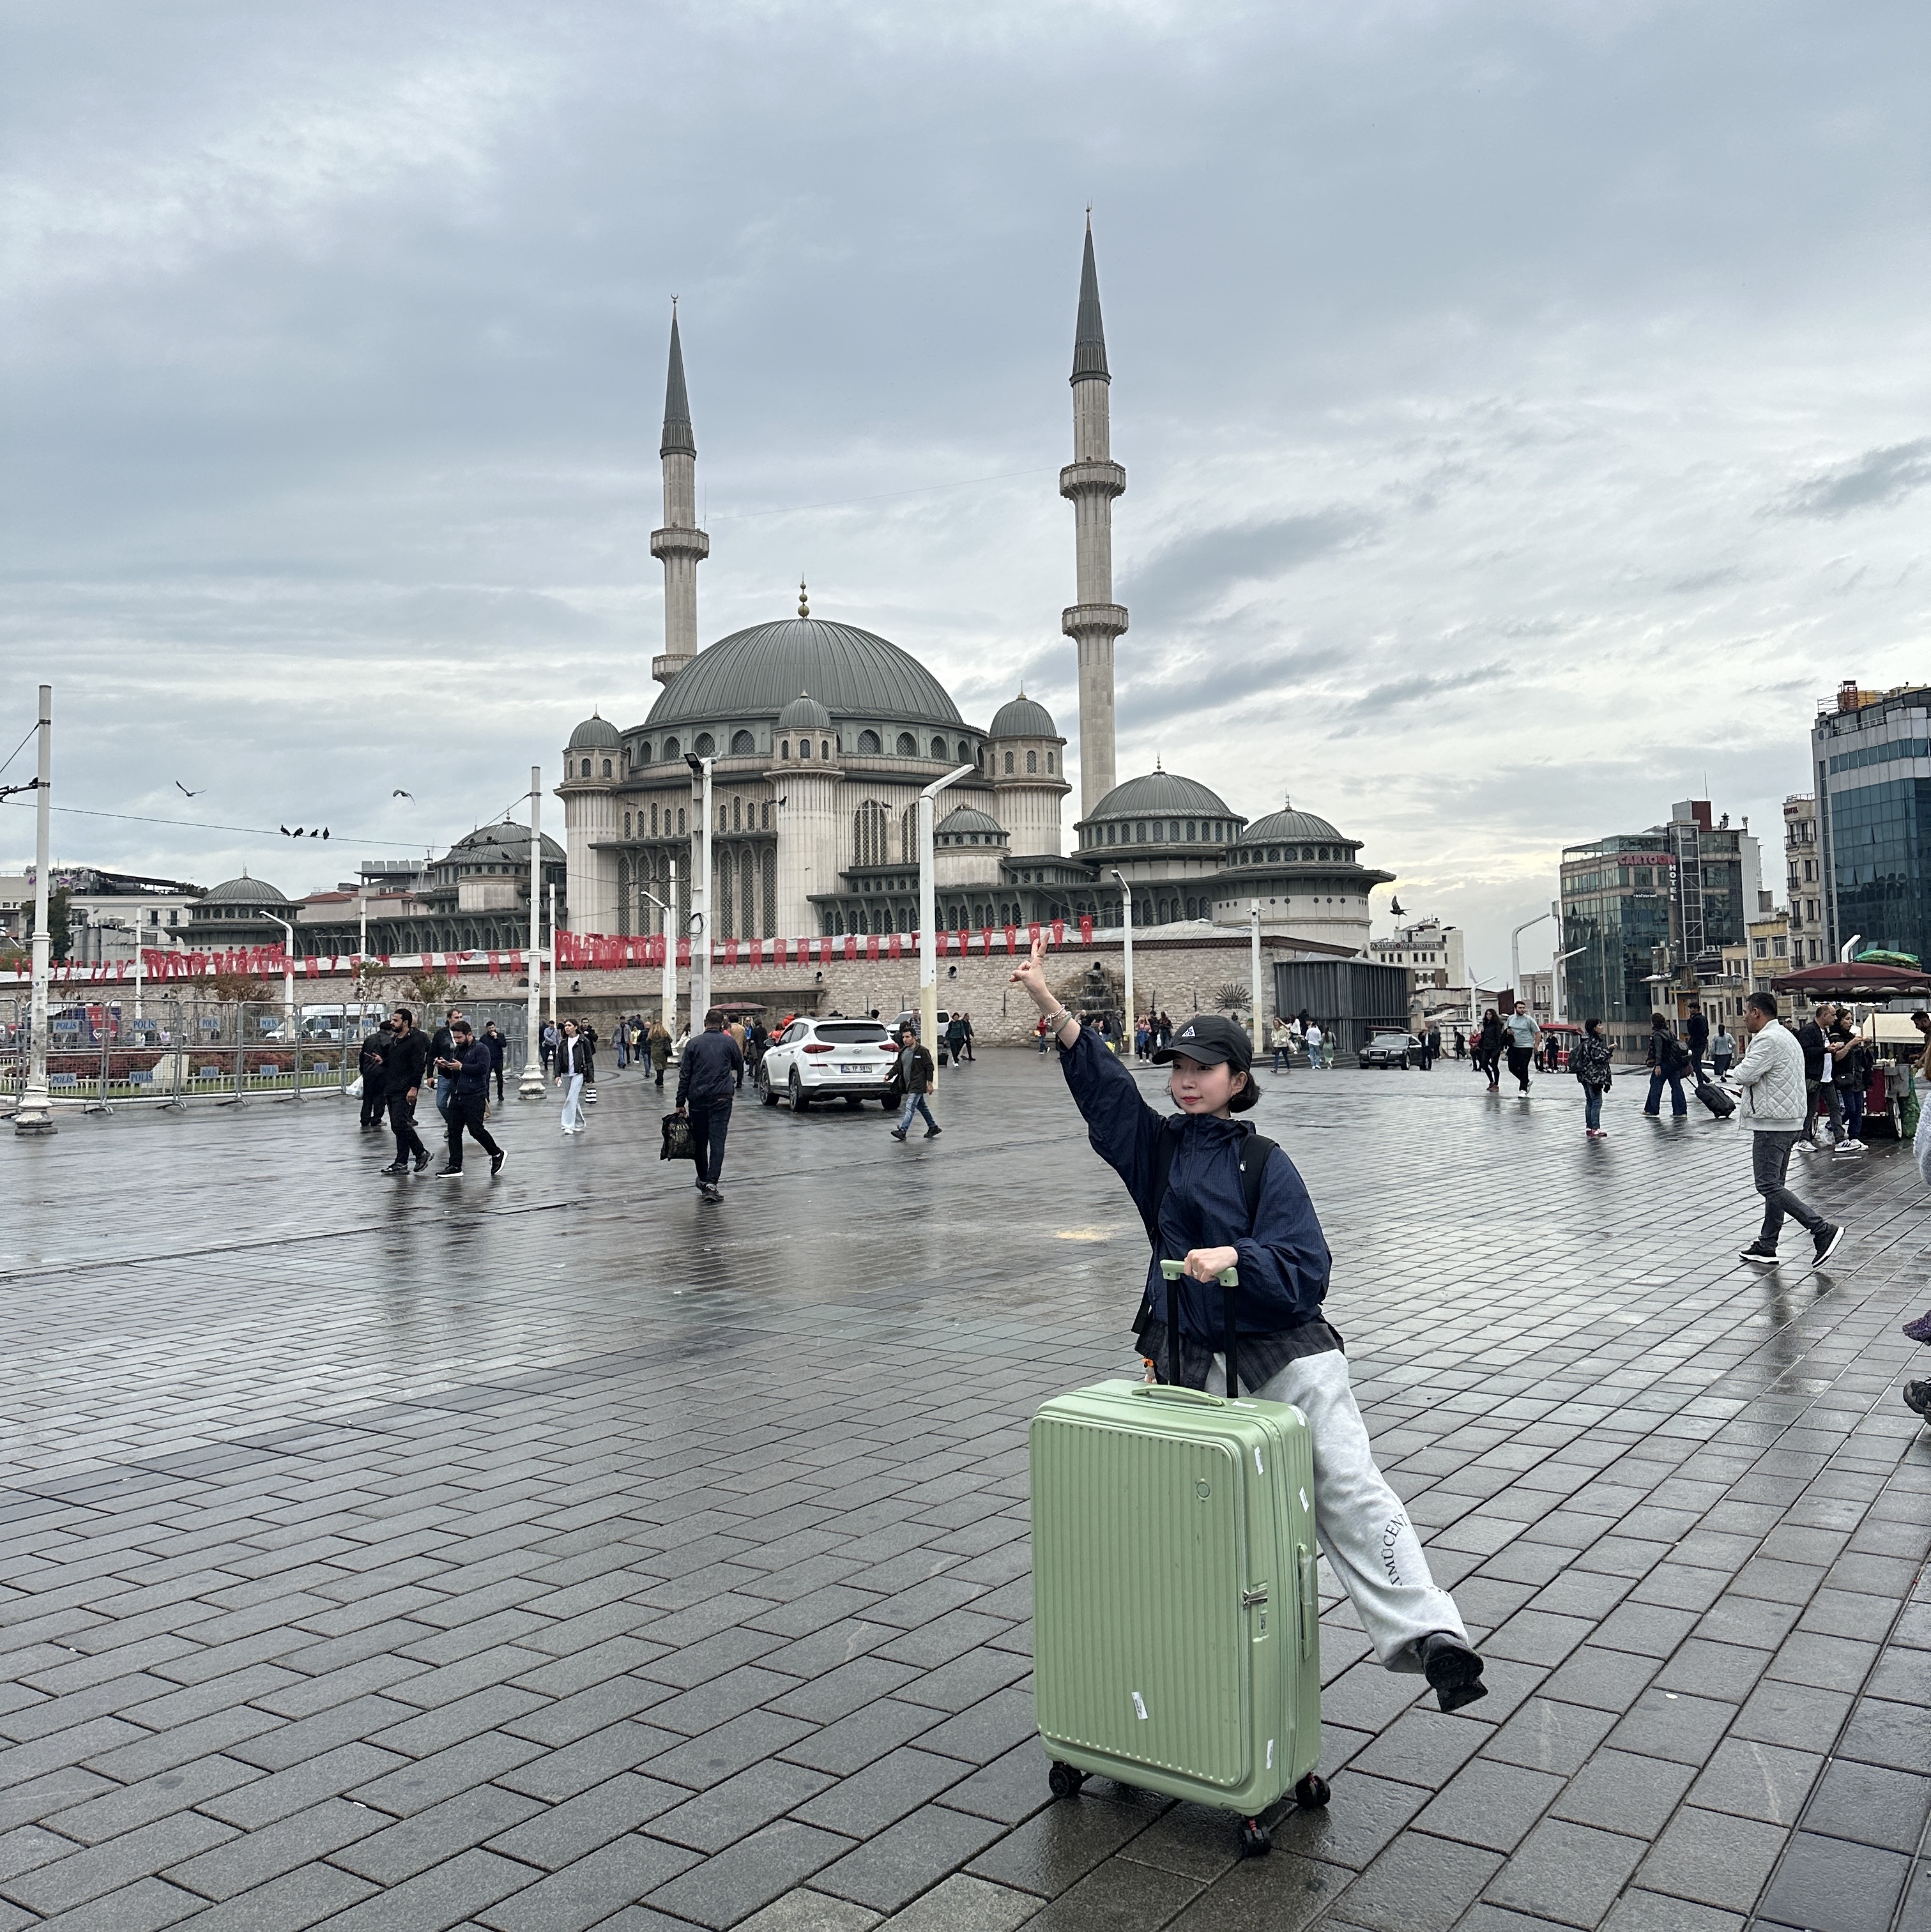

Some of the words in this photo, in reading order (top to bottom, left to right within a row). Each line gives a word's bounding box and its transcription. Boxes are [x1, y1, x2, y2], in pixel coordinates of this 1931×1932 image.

[1617, 855, 1676, 865] CARTOON
[1668, 864, 1677, 901] HOTEL
[55, 1021, 77, 1030] POLİS
[133, 1019, 155, 1029] POLİS
[202, 1017, 218, 1028] POLİS
[261, 1019, 277, 1028] POLİS
[131, 1071, 153, 1082] POLİS
[202, 1067, 217, 1077] POLİS
[52, 1074, 73, 1084] POLİS
